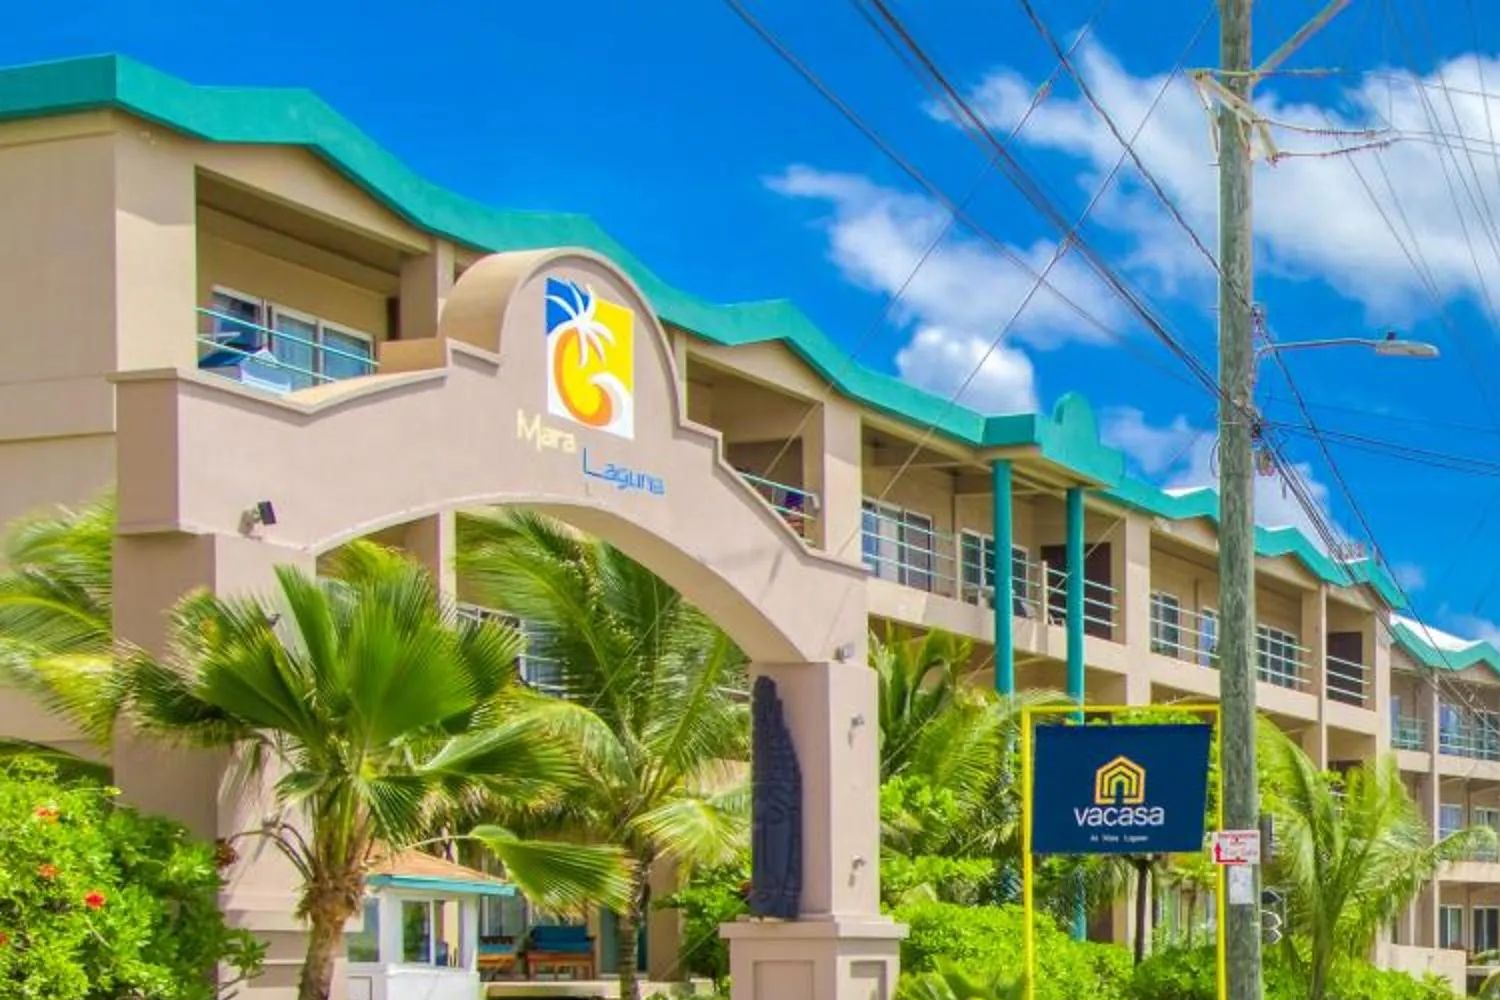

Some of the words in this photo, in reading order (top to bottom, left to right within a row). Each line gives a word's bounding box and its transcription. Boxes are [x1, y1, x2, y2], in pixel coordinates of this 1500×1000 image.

[516, 408, 577, 453] Mara
[583, 447, 666, 496] Laguna
[1073, 806, 1165, 827] vacasa
